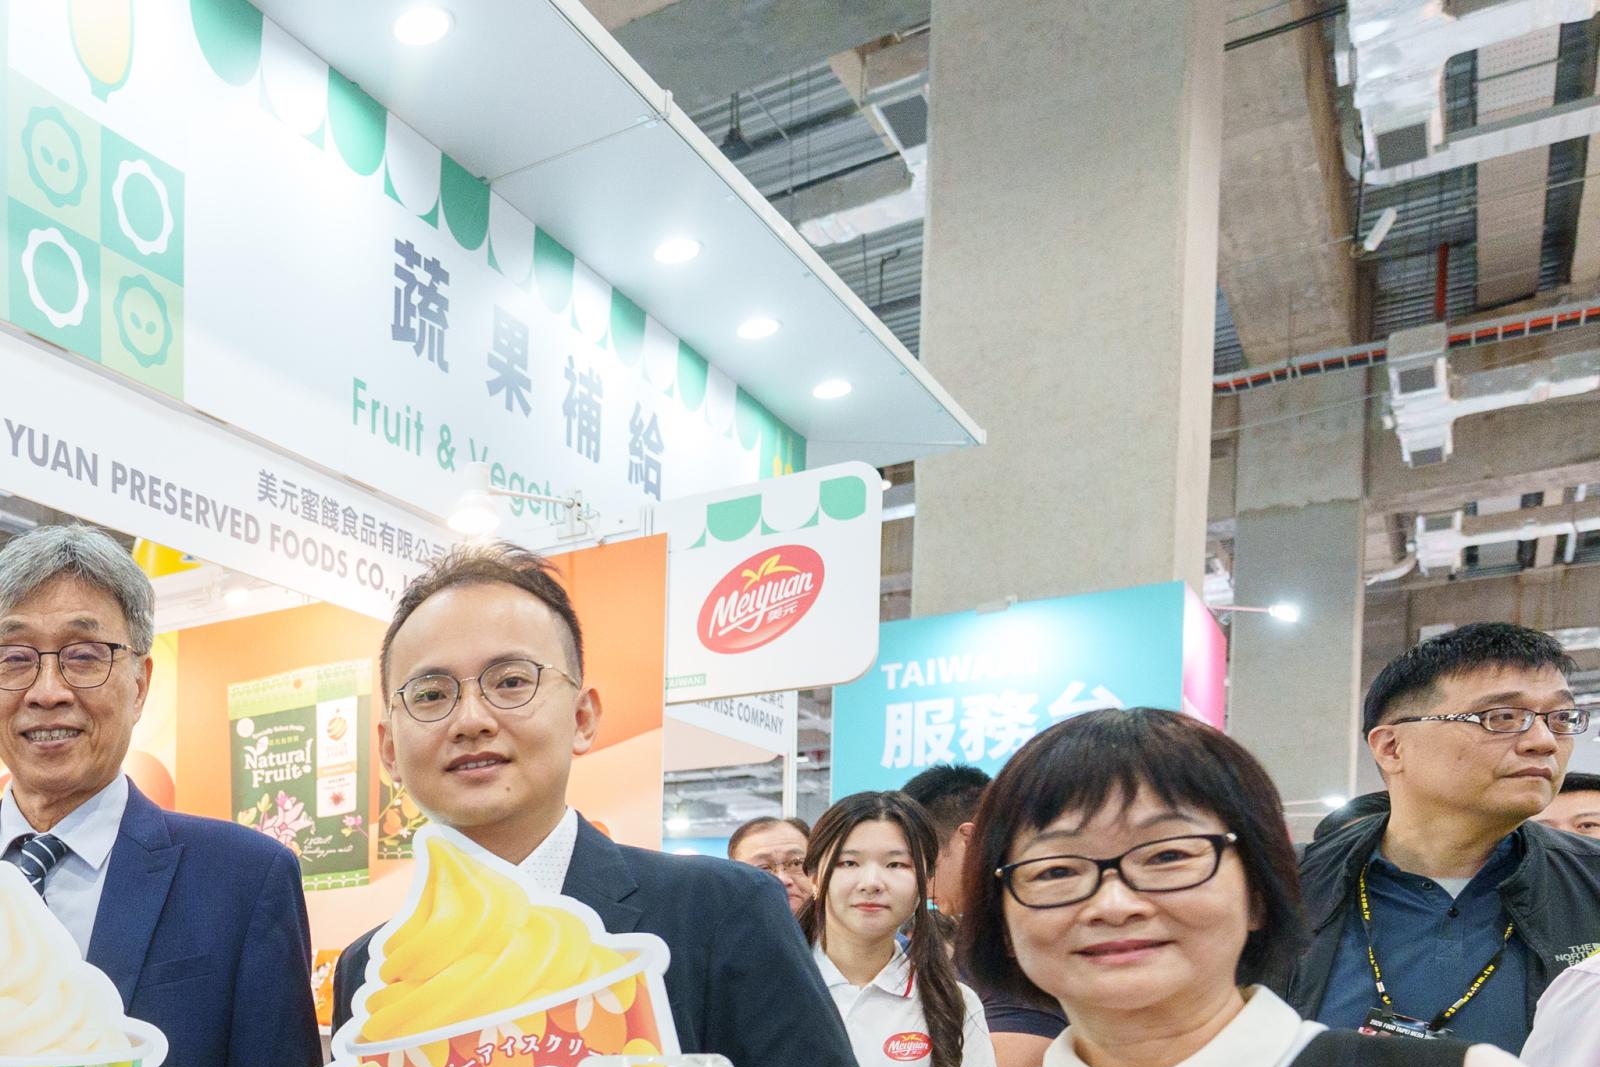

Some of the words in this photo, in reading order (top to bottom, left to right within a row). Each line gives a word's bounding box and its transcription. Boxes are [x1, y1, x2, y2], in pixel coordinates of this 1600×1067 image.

[390, 237, 665, 503] 蔬果補給
[352, 377, 424, 457] Fruit
[437, 424, 456, 472] &
[4, 418, 99, 487] YUAN
[111, 461, 261, 545] PRESERVED
[269, 522, 349, 579] FOODS
[667, 674, 706, 688] AIWAN!
[737, 701, 784, 736] COMPANY
[252, 764, 302, 788] Fruit
[1568, 943, 1592, 954] THE
